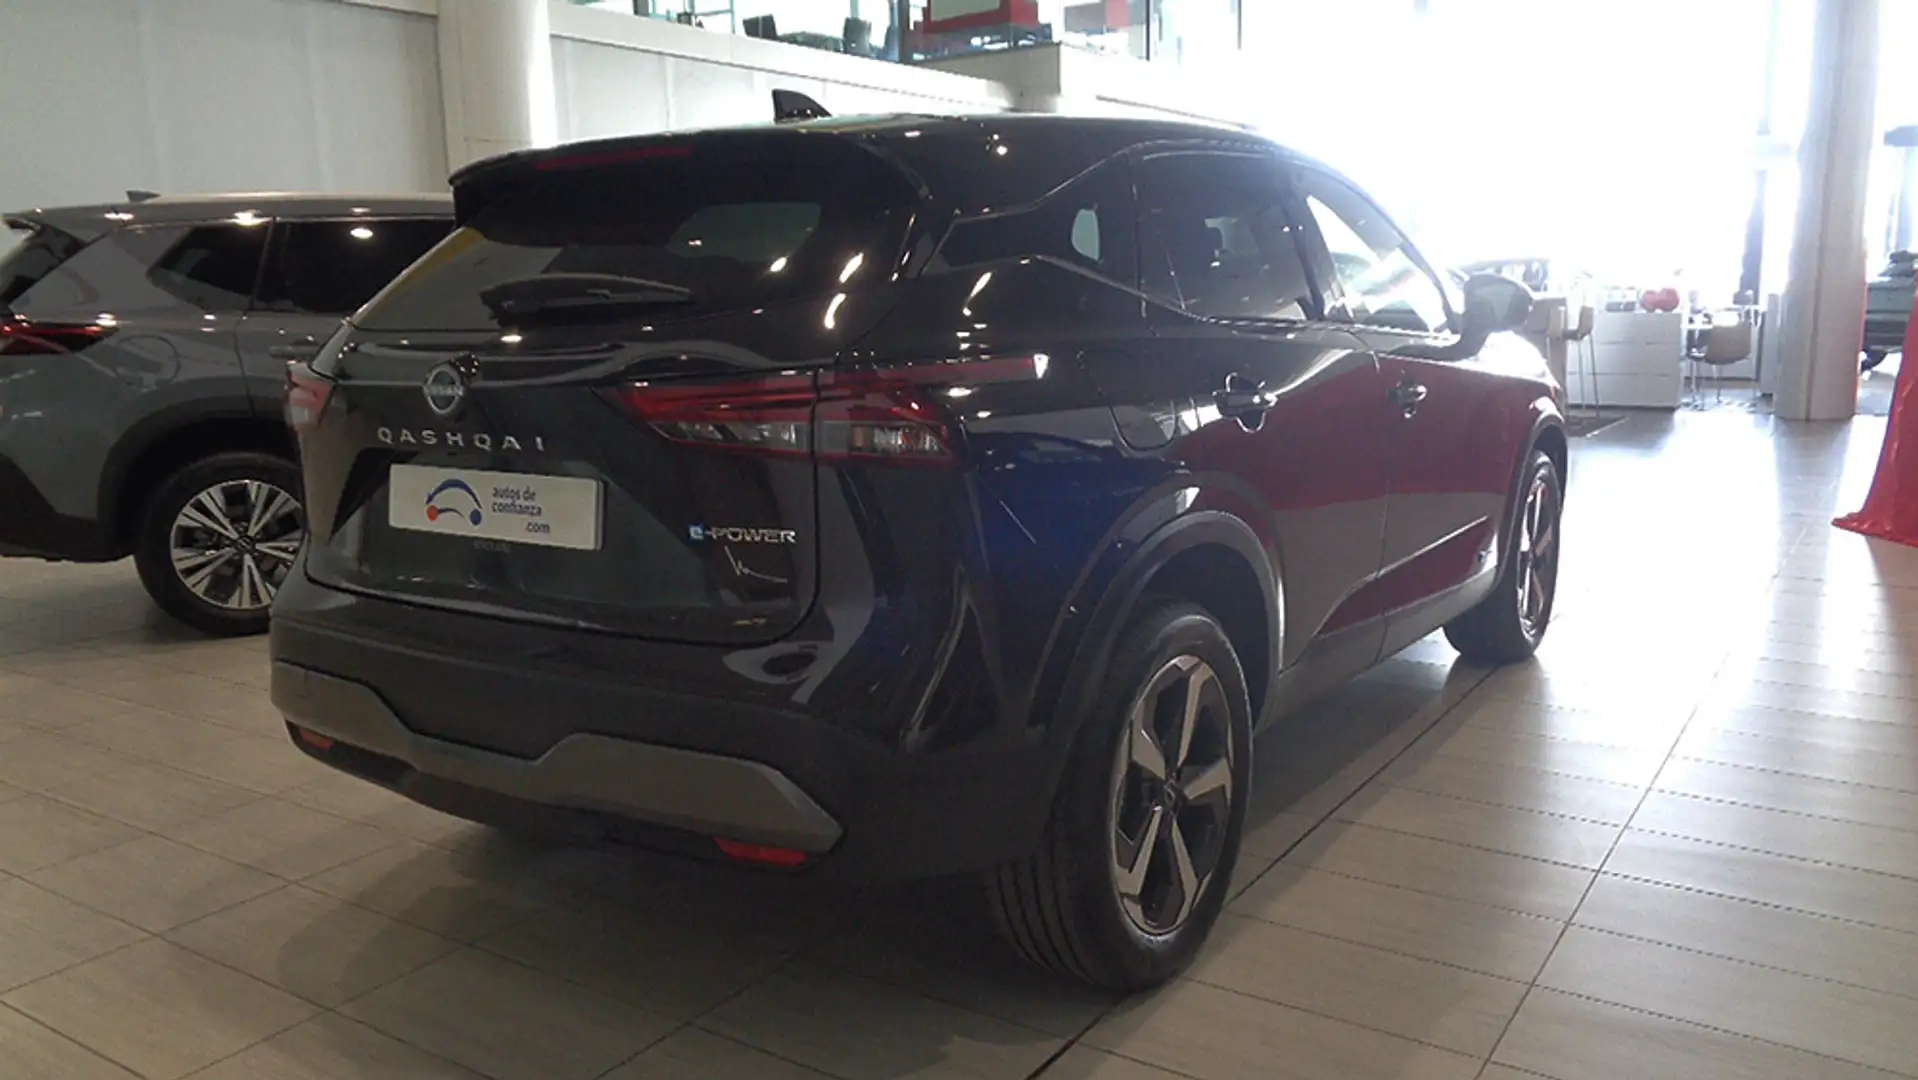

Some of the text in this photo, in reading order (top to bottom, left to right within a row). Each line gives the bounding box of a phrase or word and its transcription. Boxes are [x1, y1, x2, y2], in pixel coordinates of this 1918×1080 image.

[377, 426, 545, 451] QASHQAI
[492, 485, 536, 501] autos de
[492, 500, 542, 517] confianza
[687, 524, 797, 543] e-POWER
